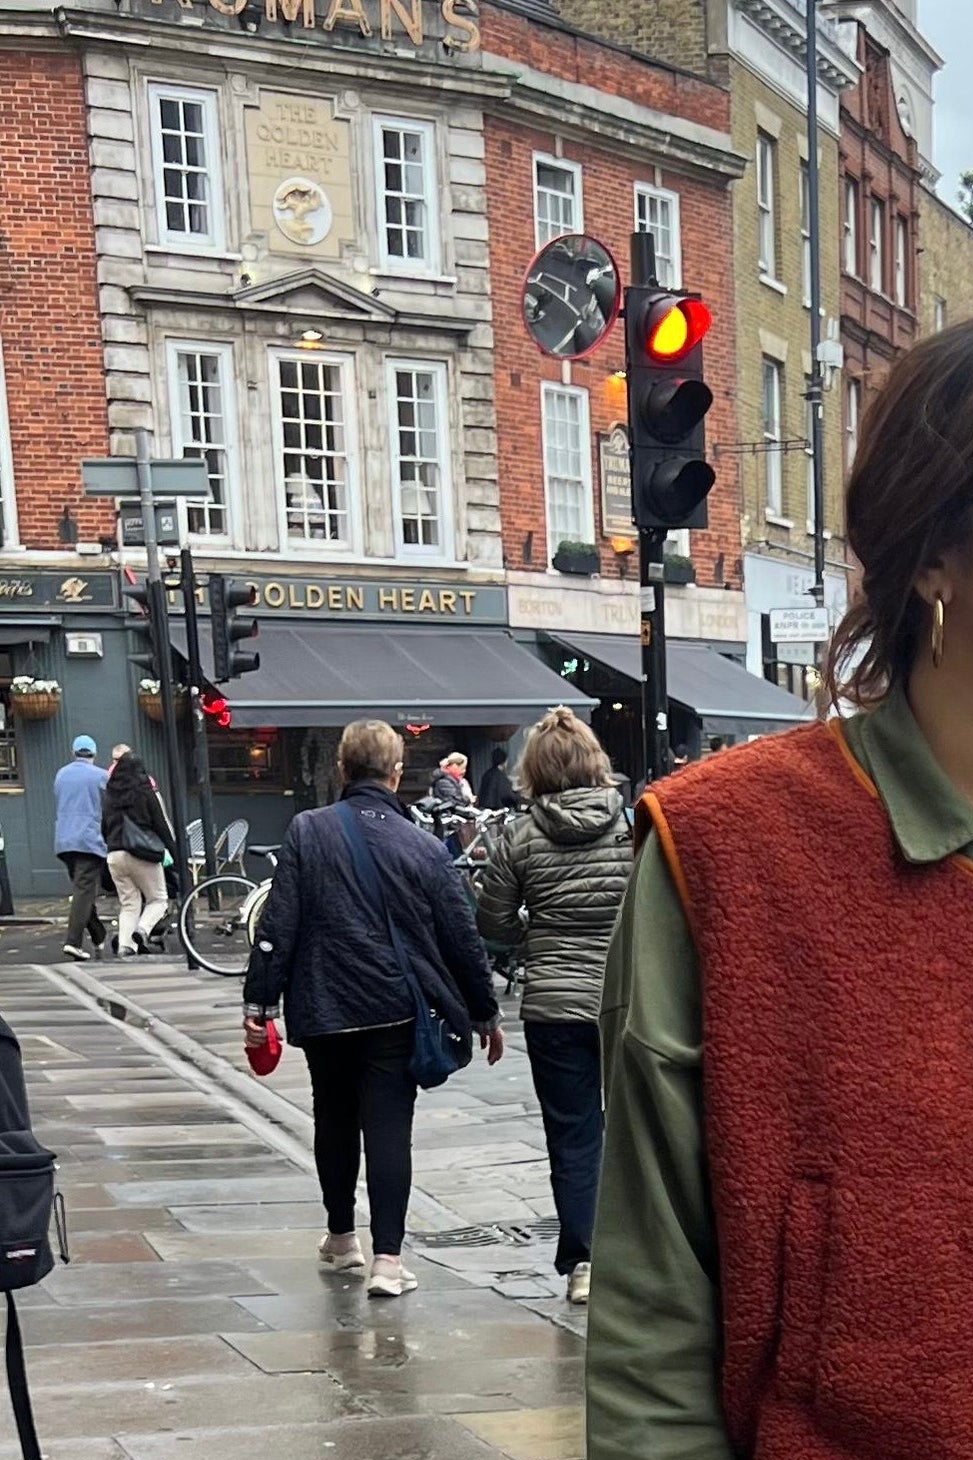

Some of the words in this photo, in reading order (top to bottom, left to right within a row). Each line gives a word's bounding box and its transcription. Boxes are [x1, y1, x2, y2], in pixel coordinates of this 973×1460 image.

[276, 104, 316, 124] THE
[256, 124, 339, 151] GOLDEN
[265, 150, 334, 174] HEART
[378, 588, 477, 614] HEART
[782, 612, 815, 620] POLICE
